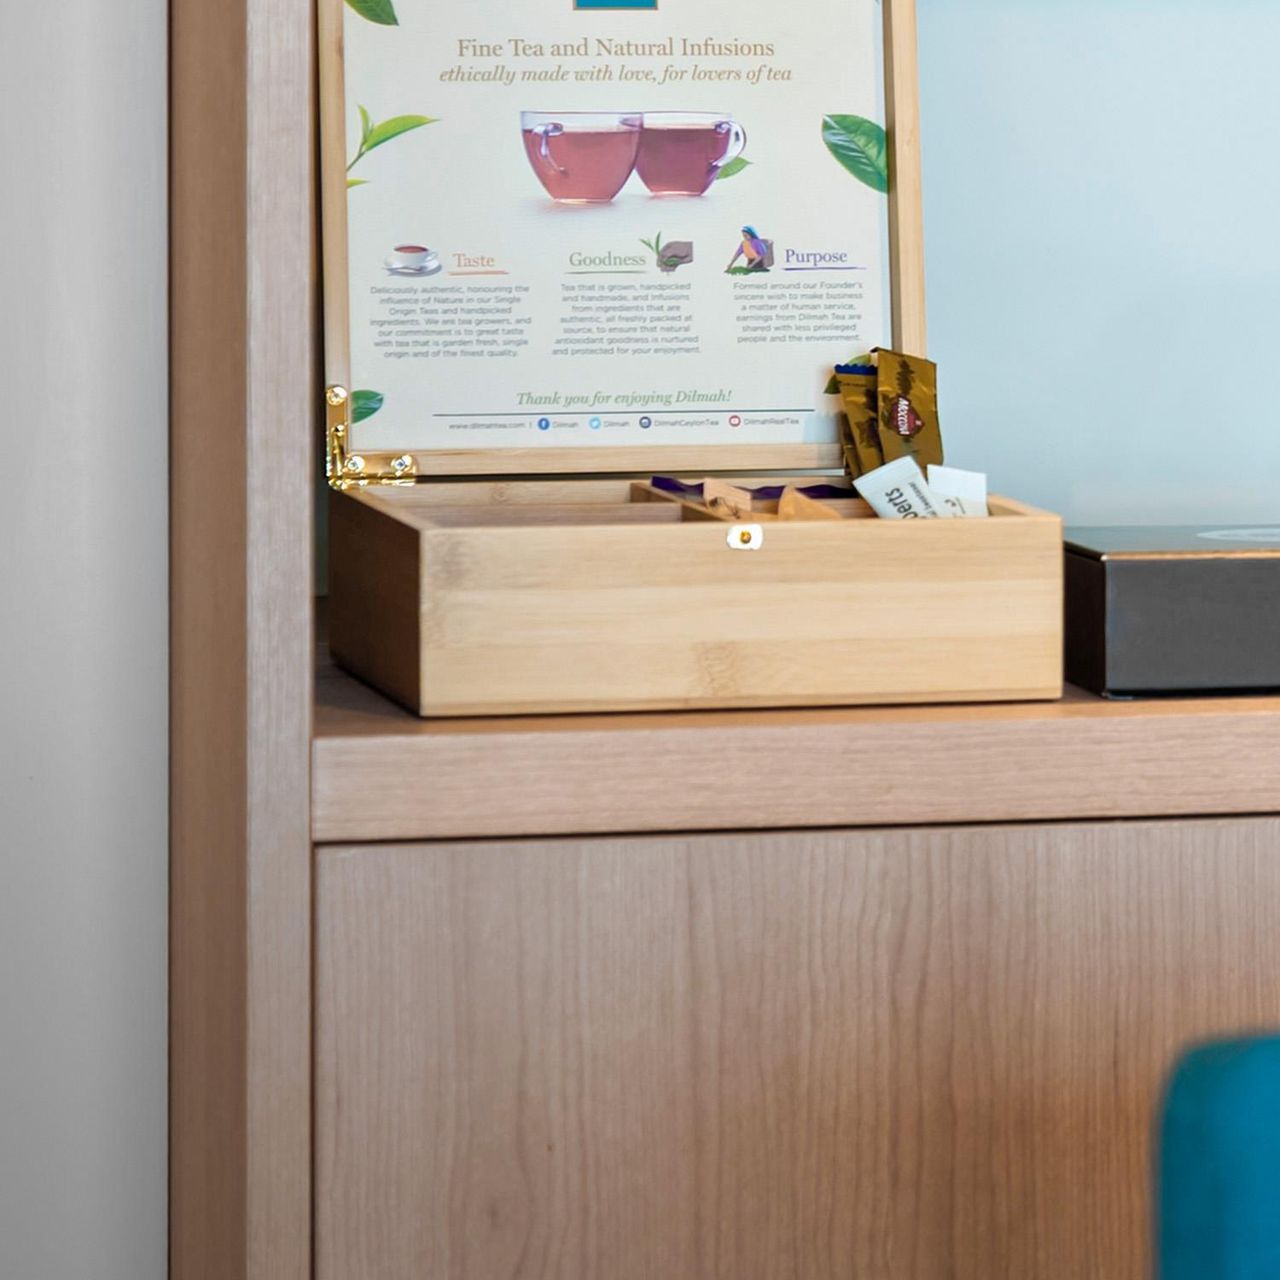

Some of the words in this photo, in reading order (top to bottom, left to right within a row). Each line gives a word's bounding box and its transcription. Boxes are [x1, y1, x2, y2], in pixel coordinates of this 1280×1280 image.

[457, 38, 503, 57] Fine
[508, 38, 546, 57] Tea
[551, 37, 591, 56] and
[595, 37, 673, 56] Natural
[678, 37, 775, 56] Infusions
[439, 64, 517, 86] ethically
[521, 64, 570, 81] made
[574, 64, 614, 81] with
[618, 64, 659, 82] love,
[660, 64, 688, 84] for
[692, 64, 742, 80] lovers
[746, 64, 764, 84] of
[768, 63, 793, 80] tea
[453, 253, 495, 268] Taste
[569, 252, 647, 267] Goodness
[785, 249, 848, 266] Purpose
[517, 392, 562, 405] Thank
[564, 396, 590, 408] you
[590, 392, 611, 408] for
[614, 391, 673, 407] enjoying
[676, 390, 732, 403] Dilmah!
